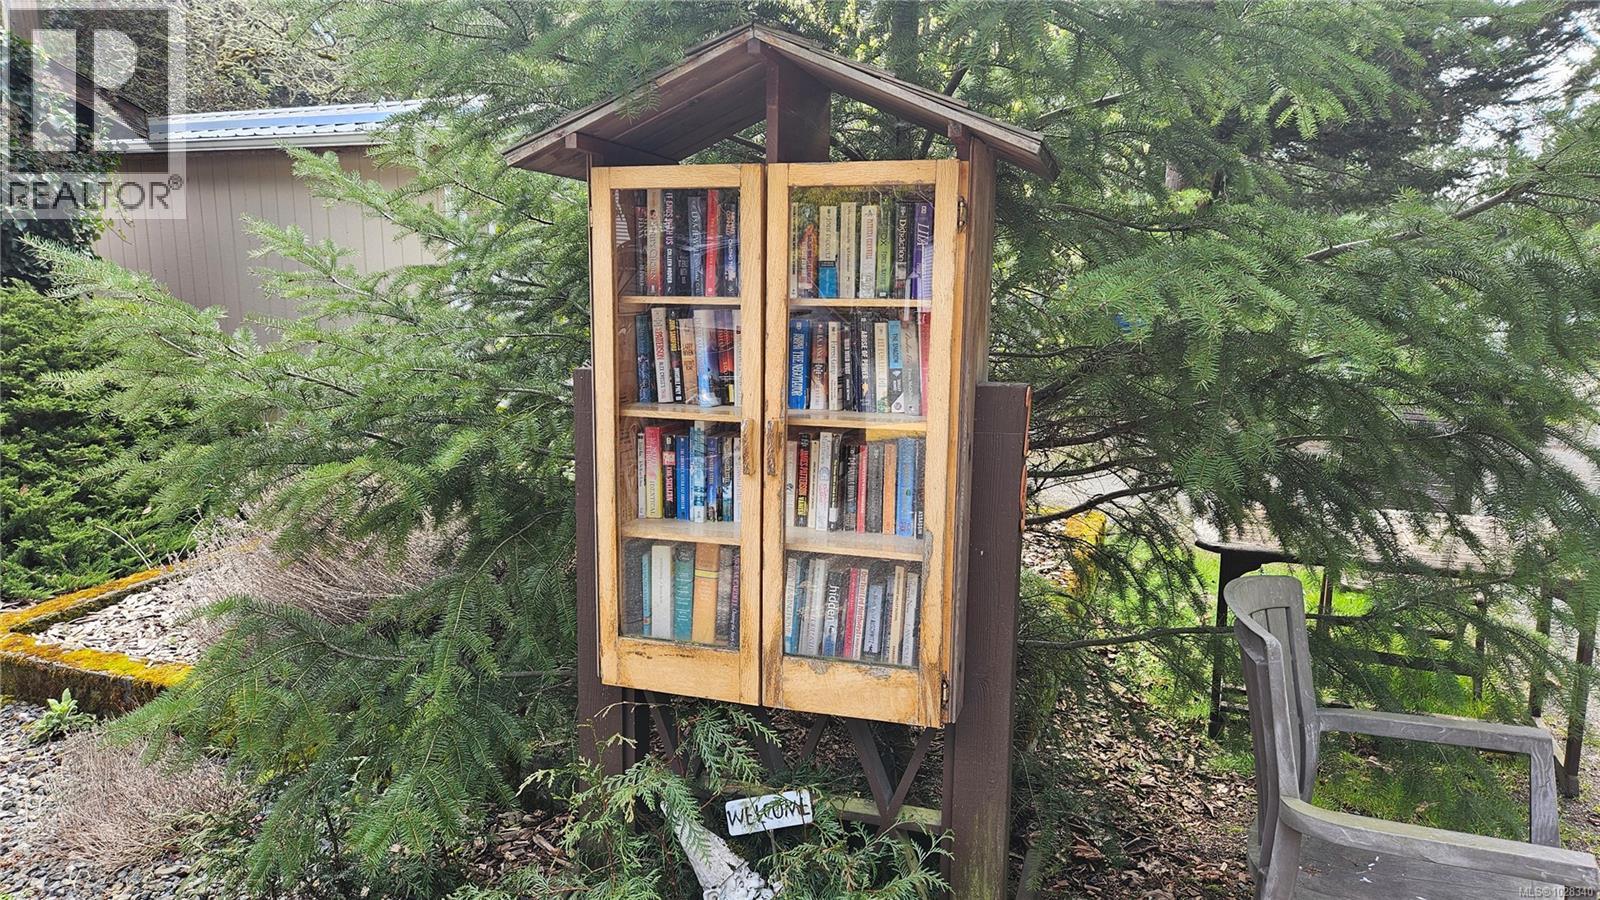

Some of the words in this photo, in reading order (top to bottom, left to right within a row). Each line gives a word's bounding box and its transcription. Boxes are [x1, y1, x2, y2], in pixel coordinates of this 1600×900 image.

[666, 236, 673, 246] US
[861, 350, 867, 358] OF
[791, 363, 802, 397] NEGOTIATOR
[798, 467, 807, 496] PATTERSON
[827, 584, 839, 623] hidden
